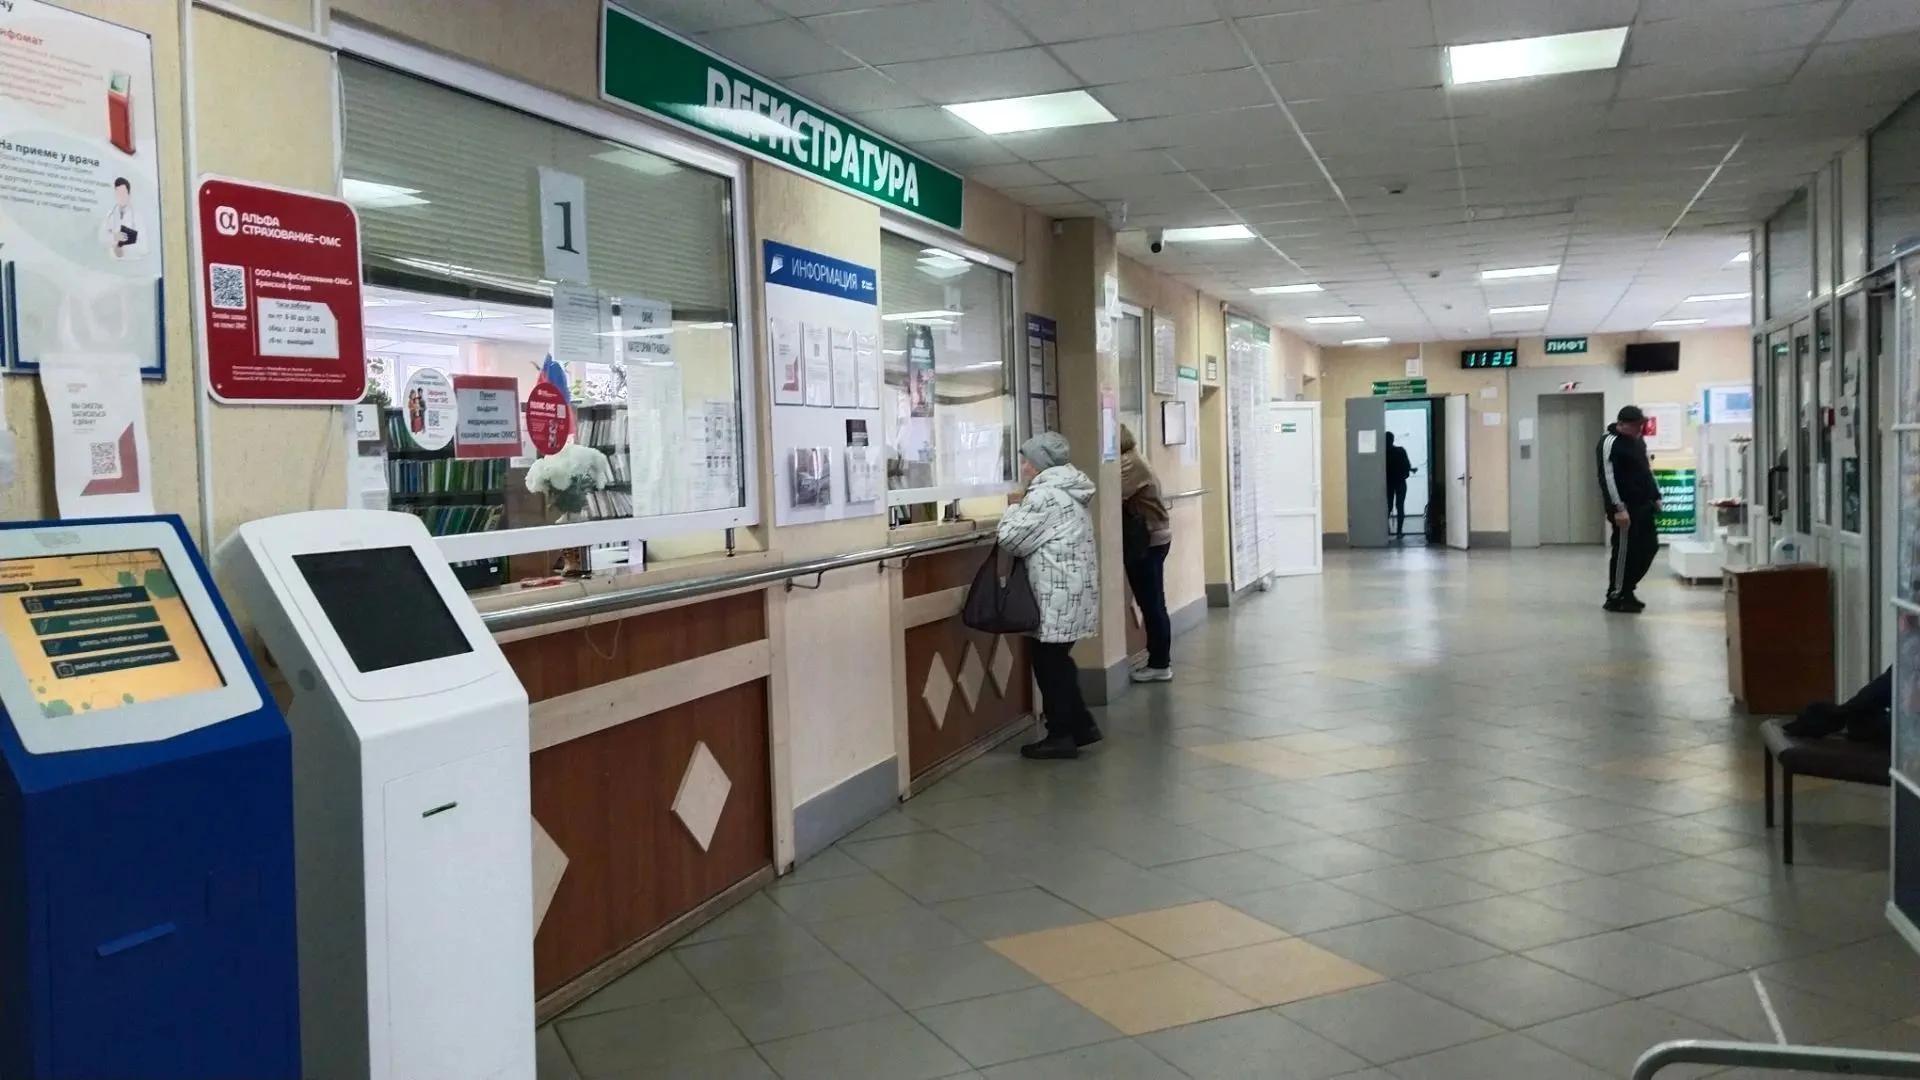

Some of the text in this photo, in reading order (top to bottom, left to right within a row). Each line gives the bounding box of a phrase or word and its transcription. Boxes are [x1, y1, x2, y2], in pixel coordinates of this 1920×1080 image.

[706, 66, 919, 207] РЕГИСТРАТУРА
[16, 144, 58, 159] приеме
[61, 152, 67, 162] у
[69, 154, 100, 167] врача
[241, 212, 280, 227] АЛЬФА
[554, 201, 580, 254] 1
[242, 224, 342, 247] СТРАХОВАНИЕ-ОМС
[791, 257, 858, 291] ИНФОРМАЦИЯ
[1547, 340, 1586, 351] ЛИФТ
